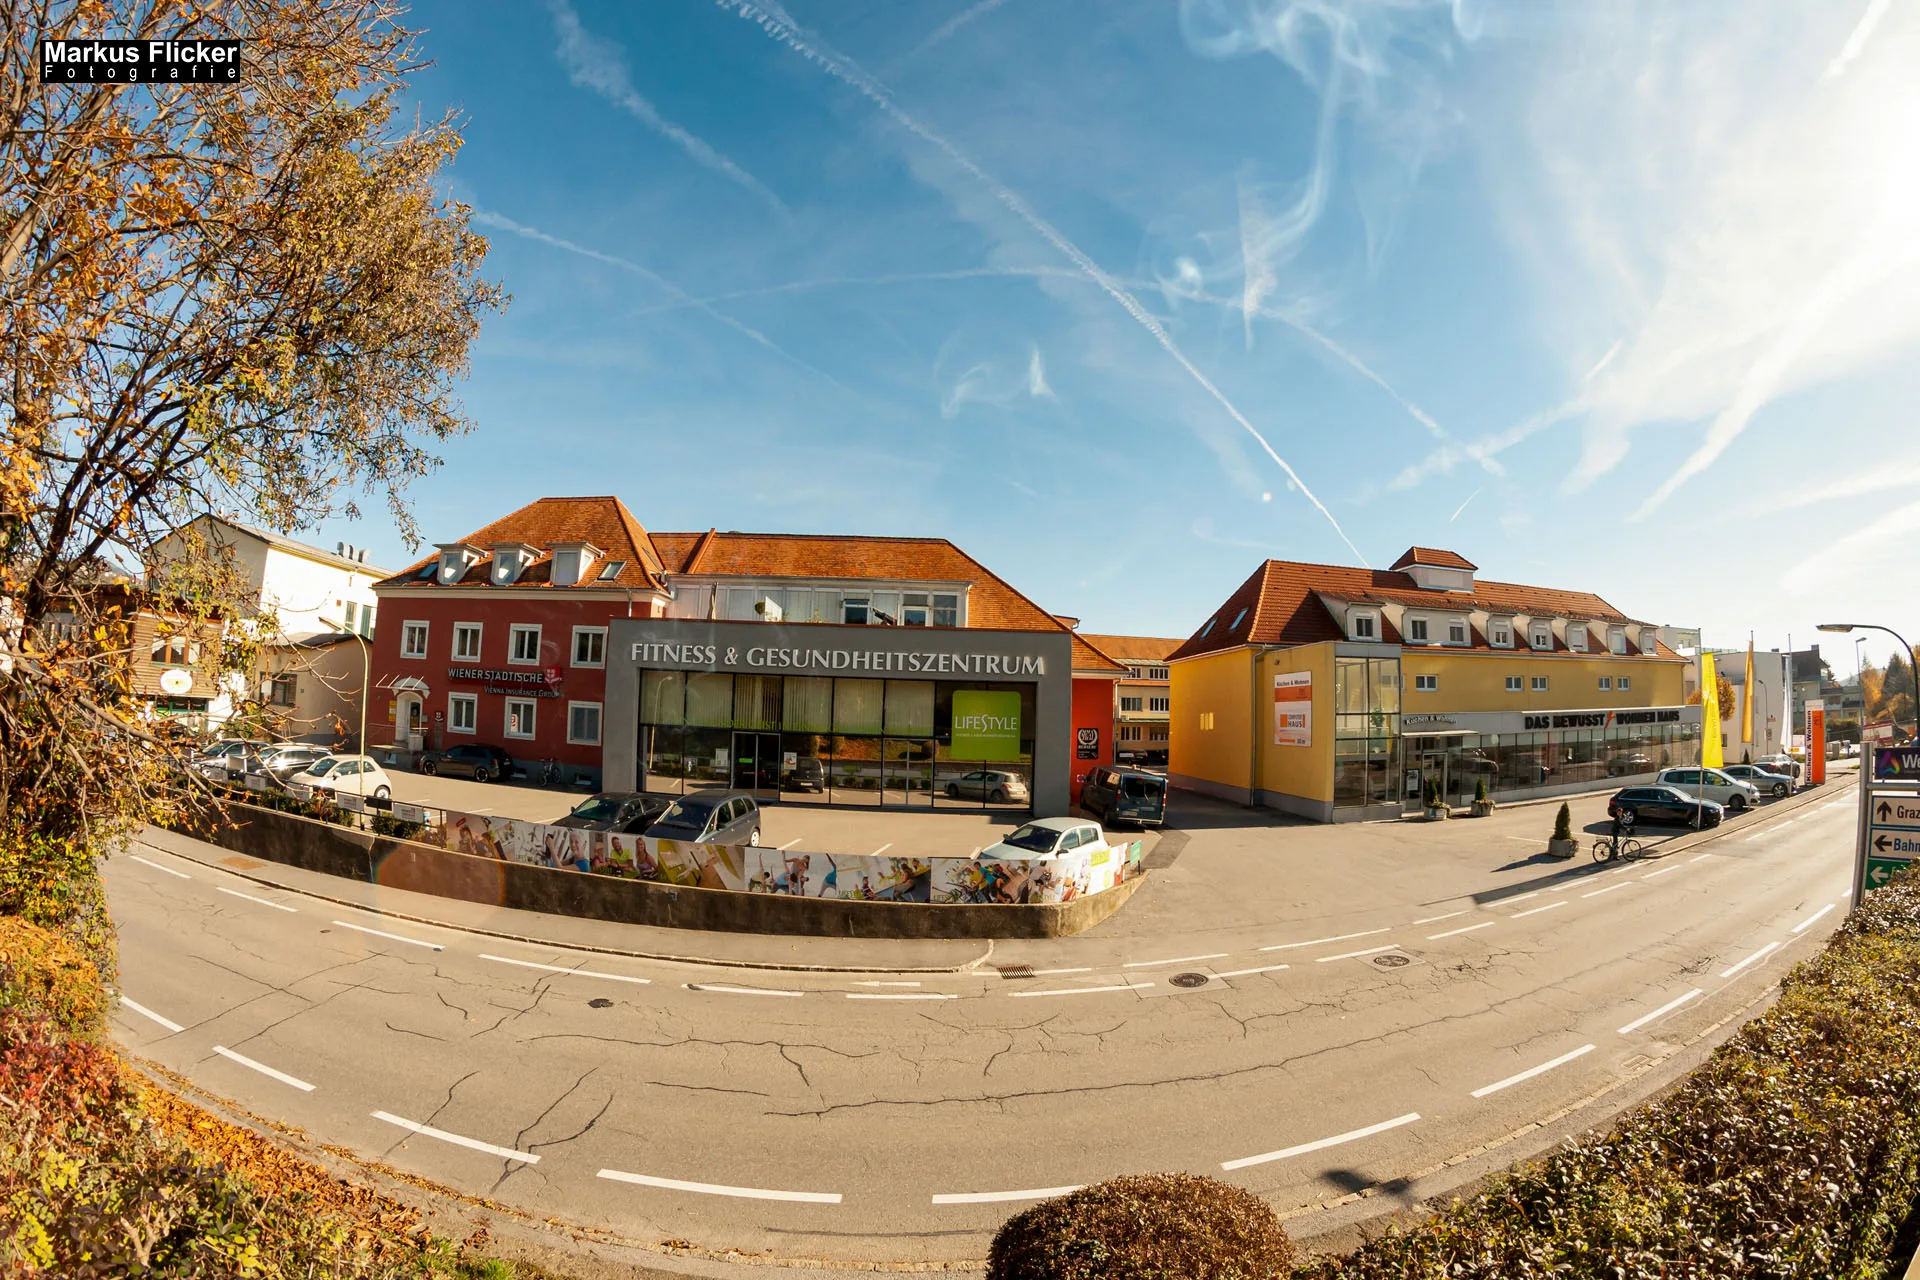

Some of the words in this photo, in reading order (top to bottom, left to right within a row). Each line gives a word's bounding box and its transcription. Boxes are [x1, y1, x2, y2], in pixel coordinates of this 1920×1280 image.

[631, 643, 716, 664] FITNESS
[724, 646, 739, 665] &
[746, 647, 1045, 675] GESUNDHEITSZENTRUM
[448, 667, 483, 680] WIENER
[955, 714, 1017, 733] LIFESTYLE
[1525, 716, 1550, 730] DAS
[1897, 805, 1920, 819] Graz
